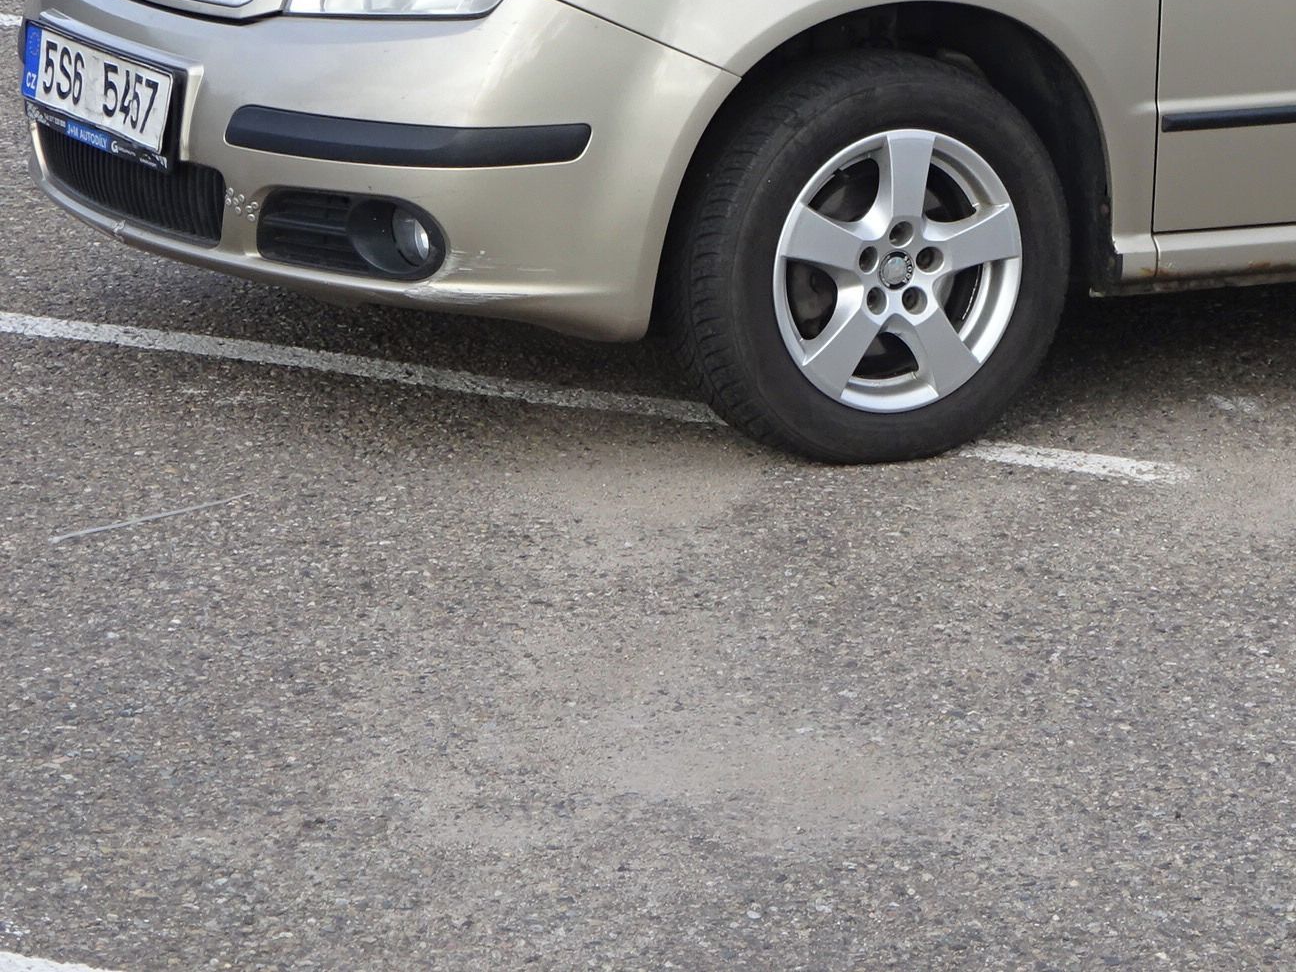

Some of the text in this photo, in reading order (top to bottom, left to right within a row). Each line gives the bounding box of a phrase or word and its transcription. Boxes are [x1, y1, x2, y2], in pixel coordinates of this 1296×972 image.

[26, 71, 37, 90] CZ
[42, 39, 159, 134] 5S6 5457
